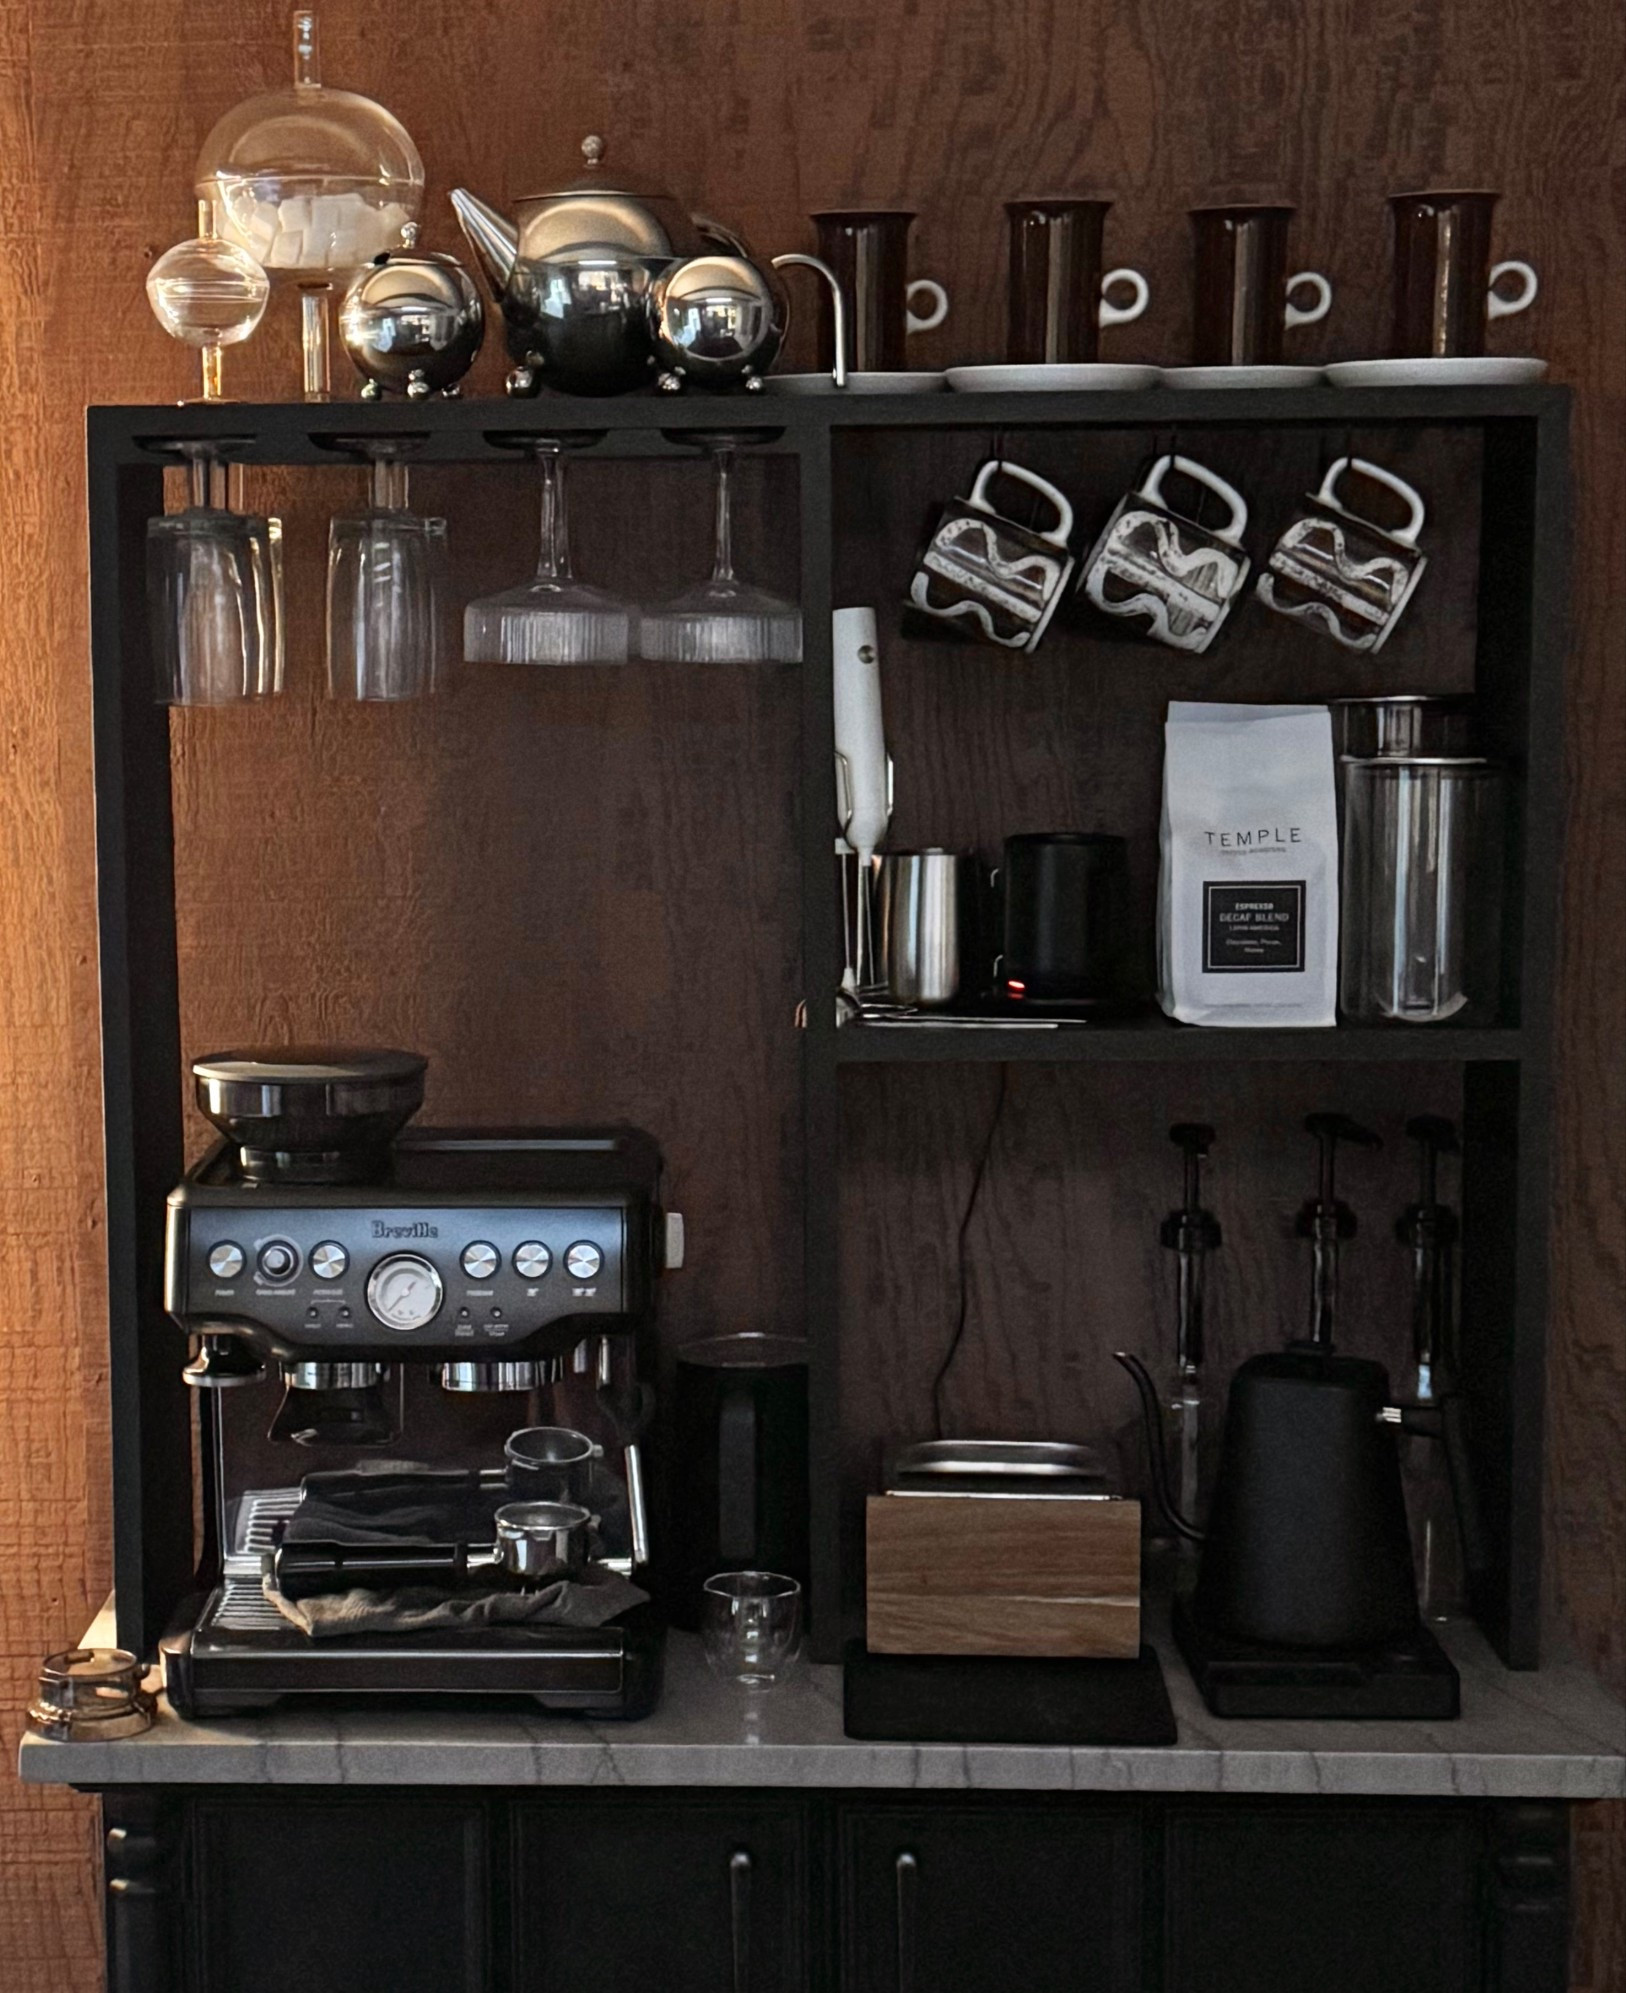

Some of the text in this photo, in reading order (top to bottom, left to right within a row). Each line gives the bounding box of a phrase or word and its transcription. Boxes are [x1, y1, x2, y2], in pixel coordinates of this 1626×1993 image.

[1204, 827, 1302, 847] TEMPLE
[1235, 902, 1274, 910] ESPRESSO
[1219, 912, 1290, 922] DECAF BLEND
[371, 1219, 439, 1239] Breville
